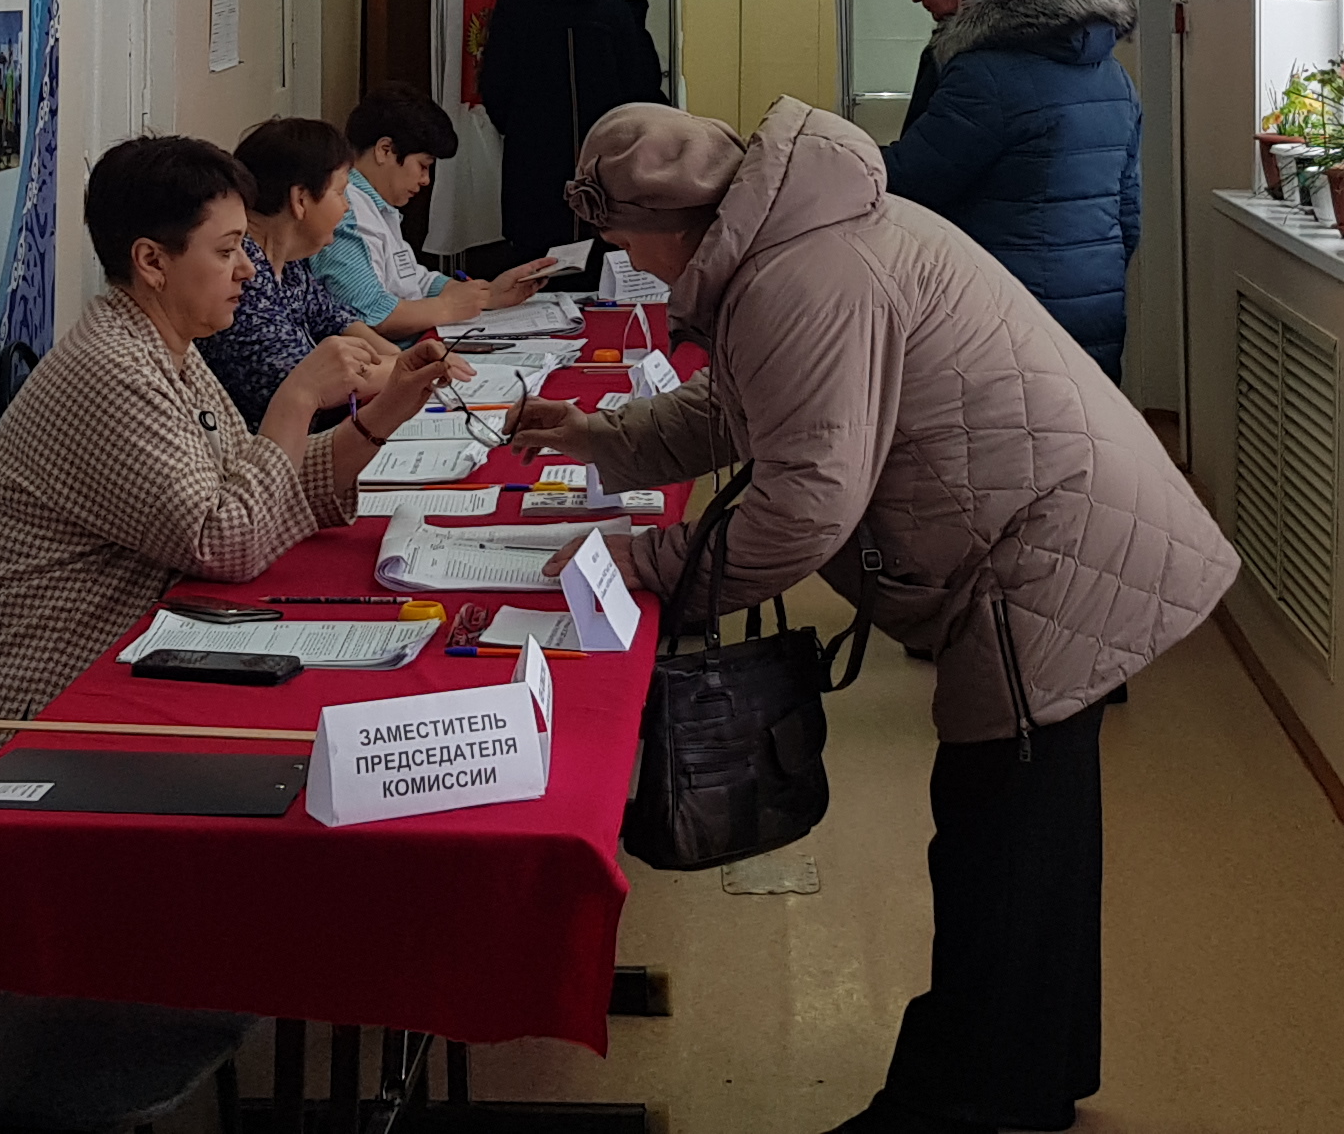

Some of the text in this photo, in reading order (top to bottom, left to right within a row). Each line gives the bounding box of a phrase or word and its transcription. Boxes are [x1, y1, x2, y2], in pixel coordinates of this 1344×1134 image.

[358, 713, 507, 747] ЗАМЕСТИТЕЛЬ
[355, 737, 518, 775] ПРЕДСЕДАТЕЛЯ
[382, 767, 497, 799] КОМИССИИ
